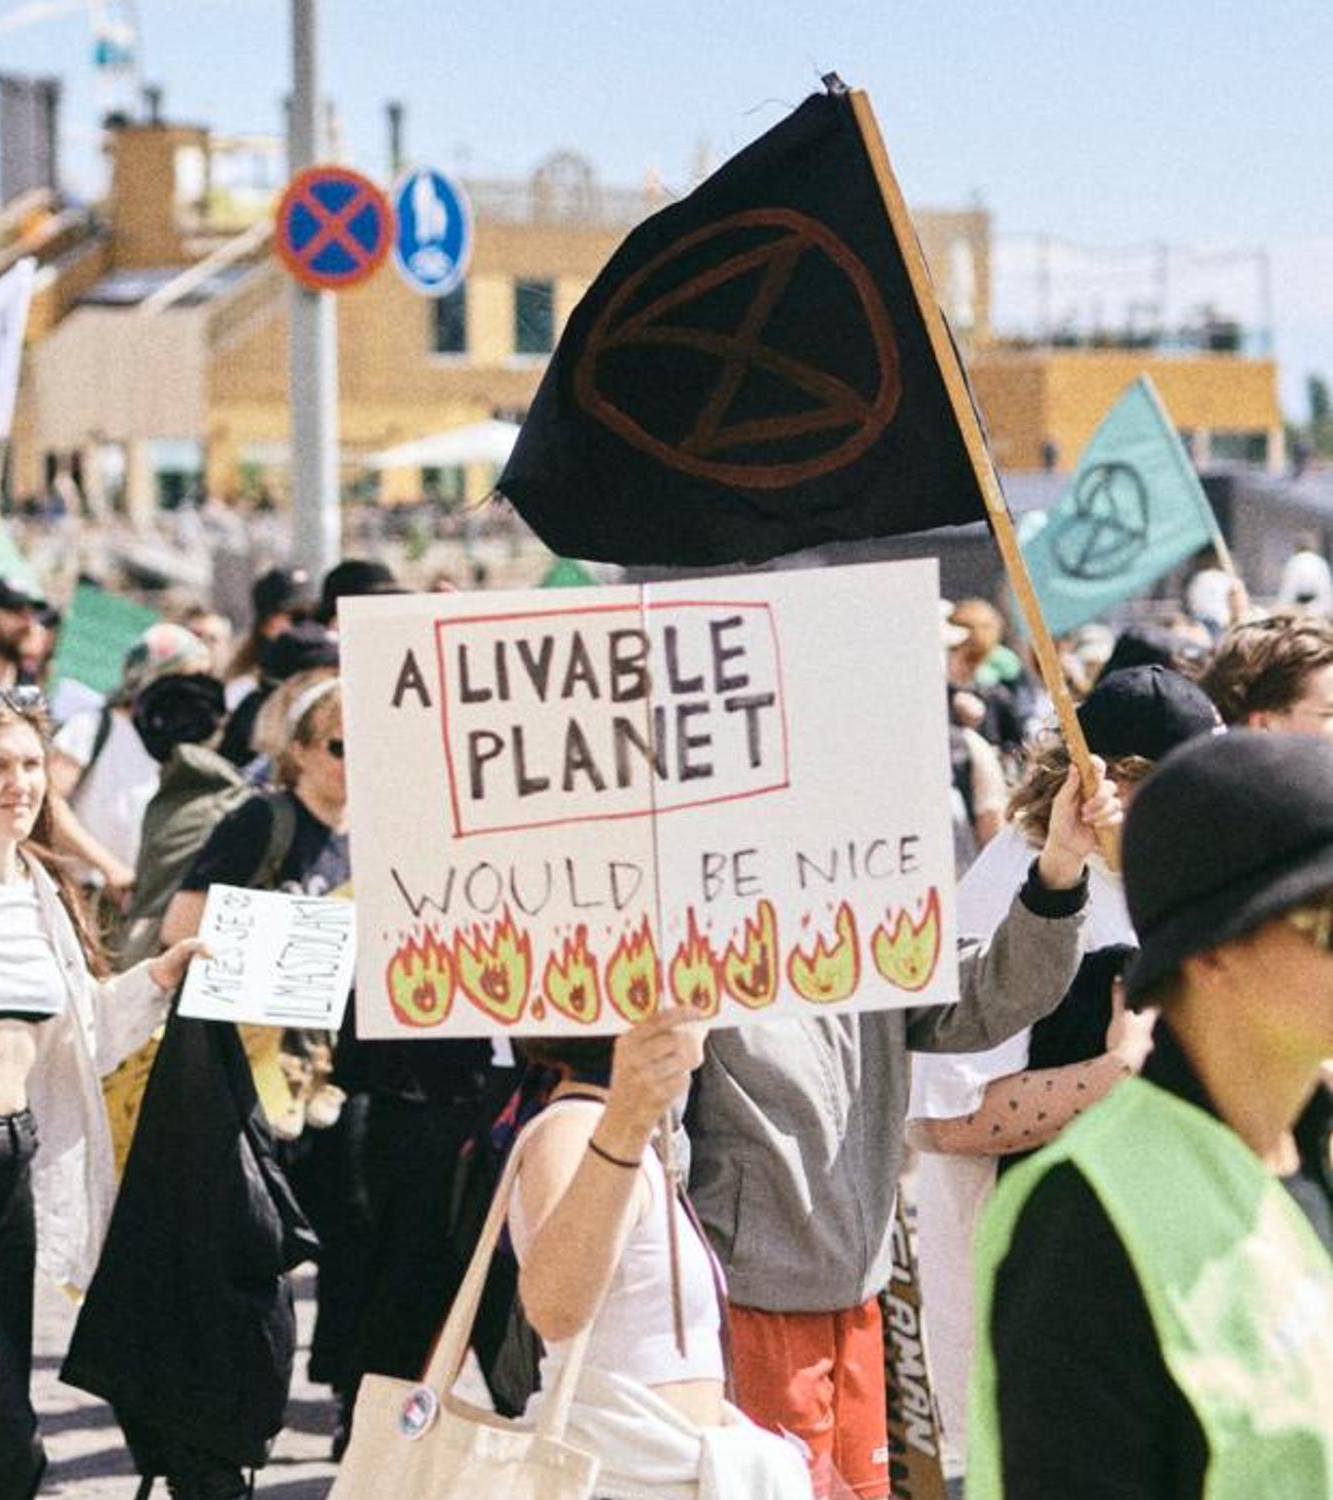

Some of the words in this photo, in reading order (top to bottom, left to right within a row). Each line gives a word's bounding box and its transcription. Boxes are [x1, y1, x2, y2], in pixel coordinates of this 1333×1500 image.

[390, 648, 433, 708] A
[456, 615, 750, 704] LIVABLE
[468, 692, 776, 800] PLANET
[390, 857, 644, 918] WOULD
[700, 847, 763, 902] BE
[795, 834, 921, 889] NICE
